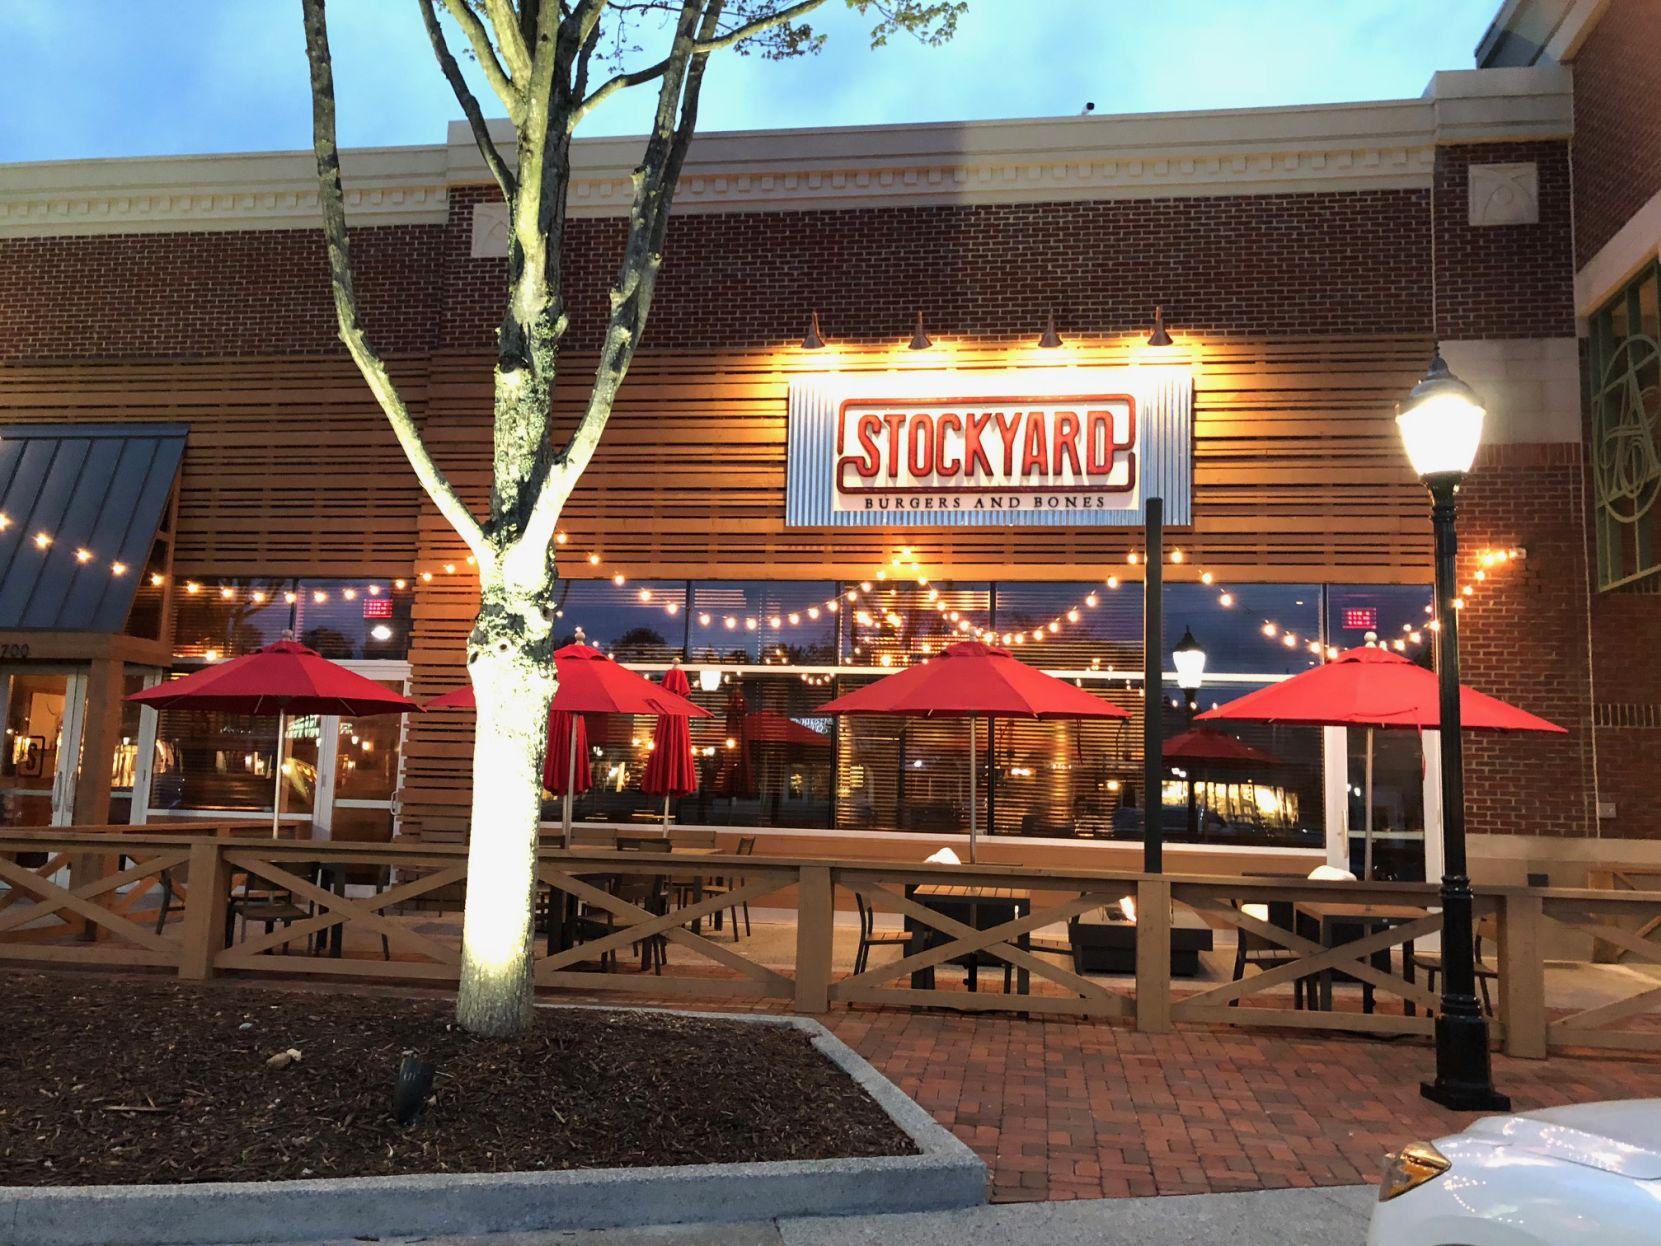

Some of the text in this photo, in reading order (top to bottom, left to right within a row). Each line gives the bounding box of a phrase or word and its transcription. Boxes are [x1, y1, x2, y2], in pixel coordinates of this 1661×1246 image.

[857, 410, 1114, 477] STOCKYARD
[865, 496, 1105, 509] BURGERS AND BONES
